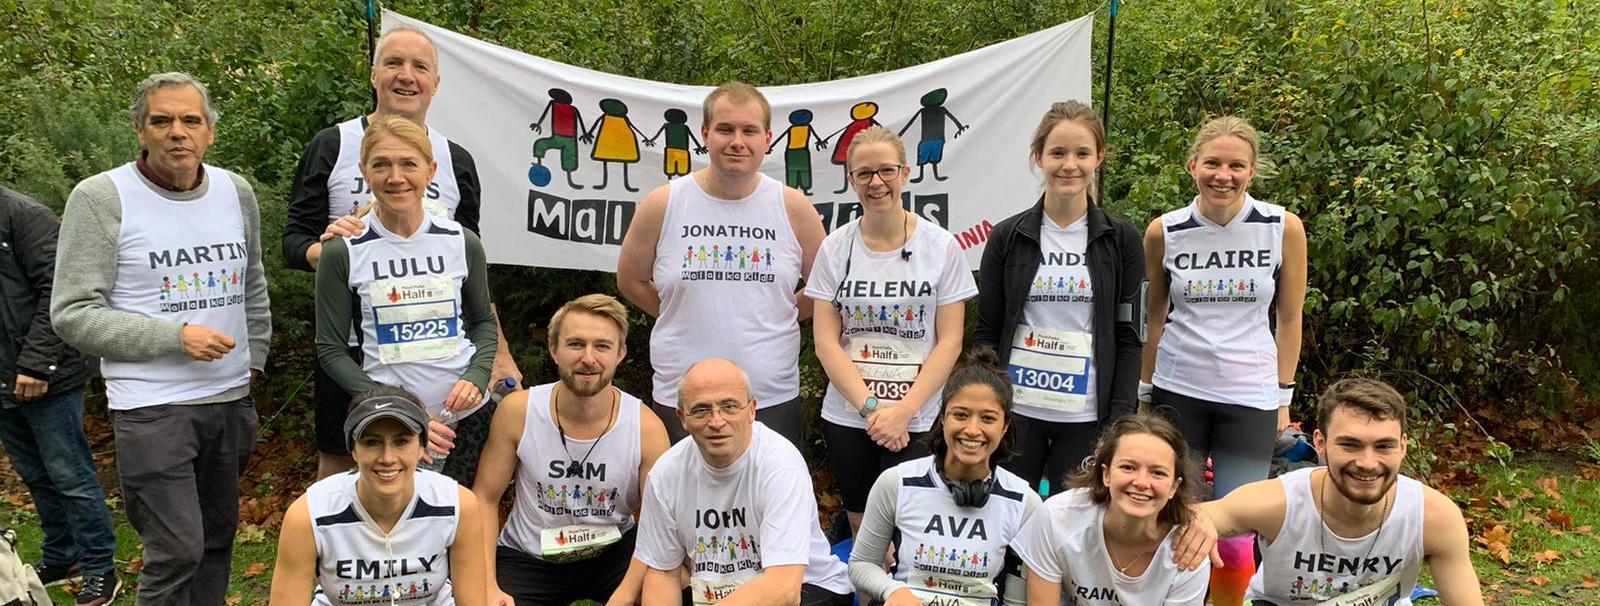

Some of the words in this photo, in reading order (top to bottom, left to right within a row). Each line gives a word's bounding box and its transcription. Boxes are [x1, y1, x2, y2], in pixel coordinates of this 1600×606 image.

[680, 224, 776, 241] JONATHON
[148, 240, 247, 270] MARTIN
[1174, 249, 1271, 270] CLAIRE
[371, 255, 445, 280] LULU
[402, 289, 426, 300] Half
[839, 280, 932, 298] HELENA
[389, 319, 449, 342] 15225
[872, 349, 893, 360] Half
[1037, 338, 1059, 351] Half
[1015, 367, 1075, 392] 13004
[548, 459, 606, 482] SAM
[568, 533, 590, 543] Half
[923, 513, 988, 541] AVA
[336, 553, 438, 580] EMILY
[1293, 550, 1403, 576] HENRY
